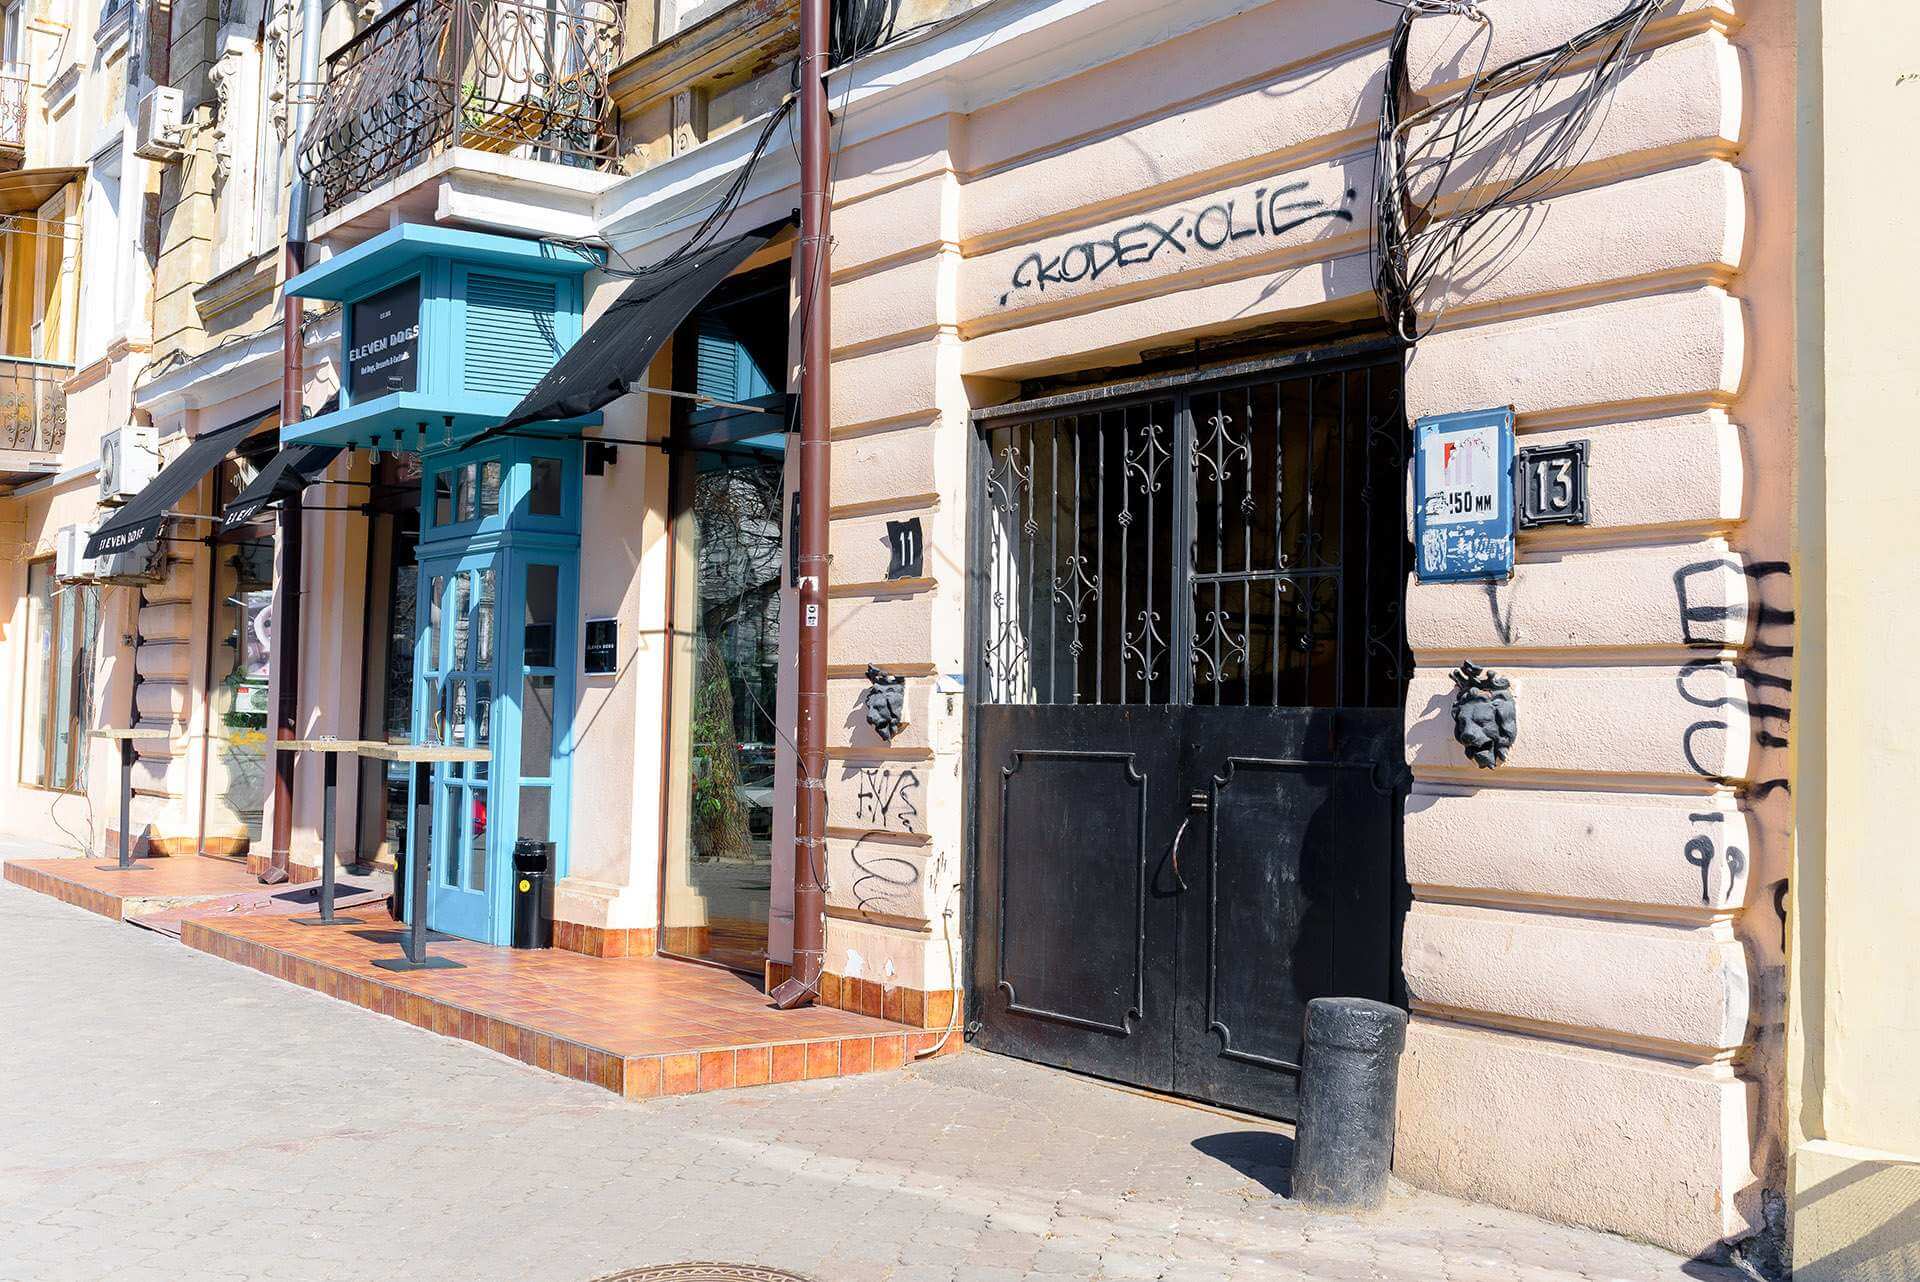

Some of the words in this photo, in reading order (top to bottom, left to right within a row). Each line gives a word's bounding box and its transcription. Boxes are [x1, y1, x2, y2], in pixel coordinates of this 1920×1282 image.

[349, 337, 388, 362] ELEVEN
[390, 324, 420, 346] DOGS
[1536, 458, 1573, 512] 13
[900, 531, 913, 566] 11
